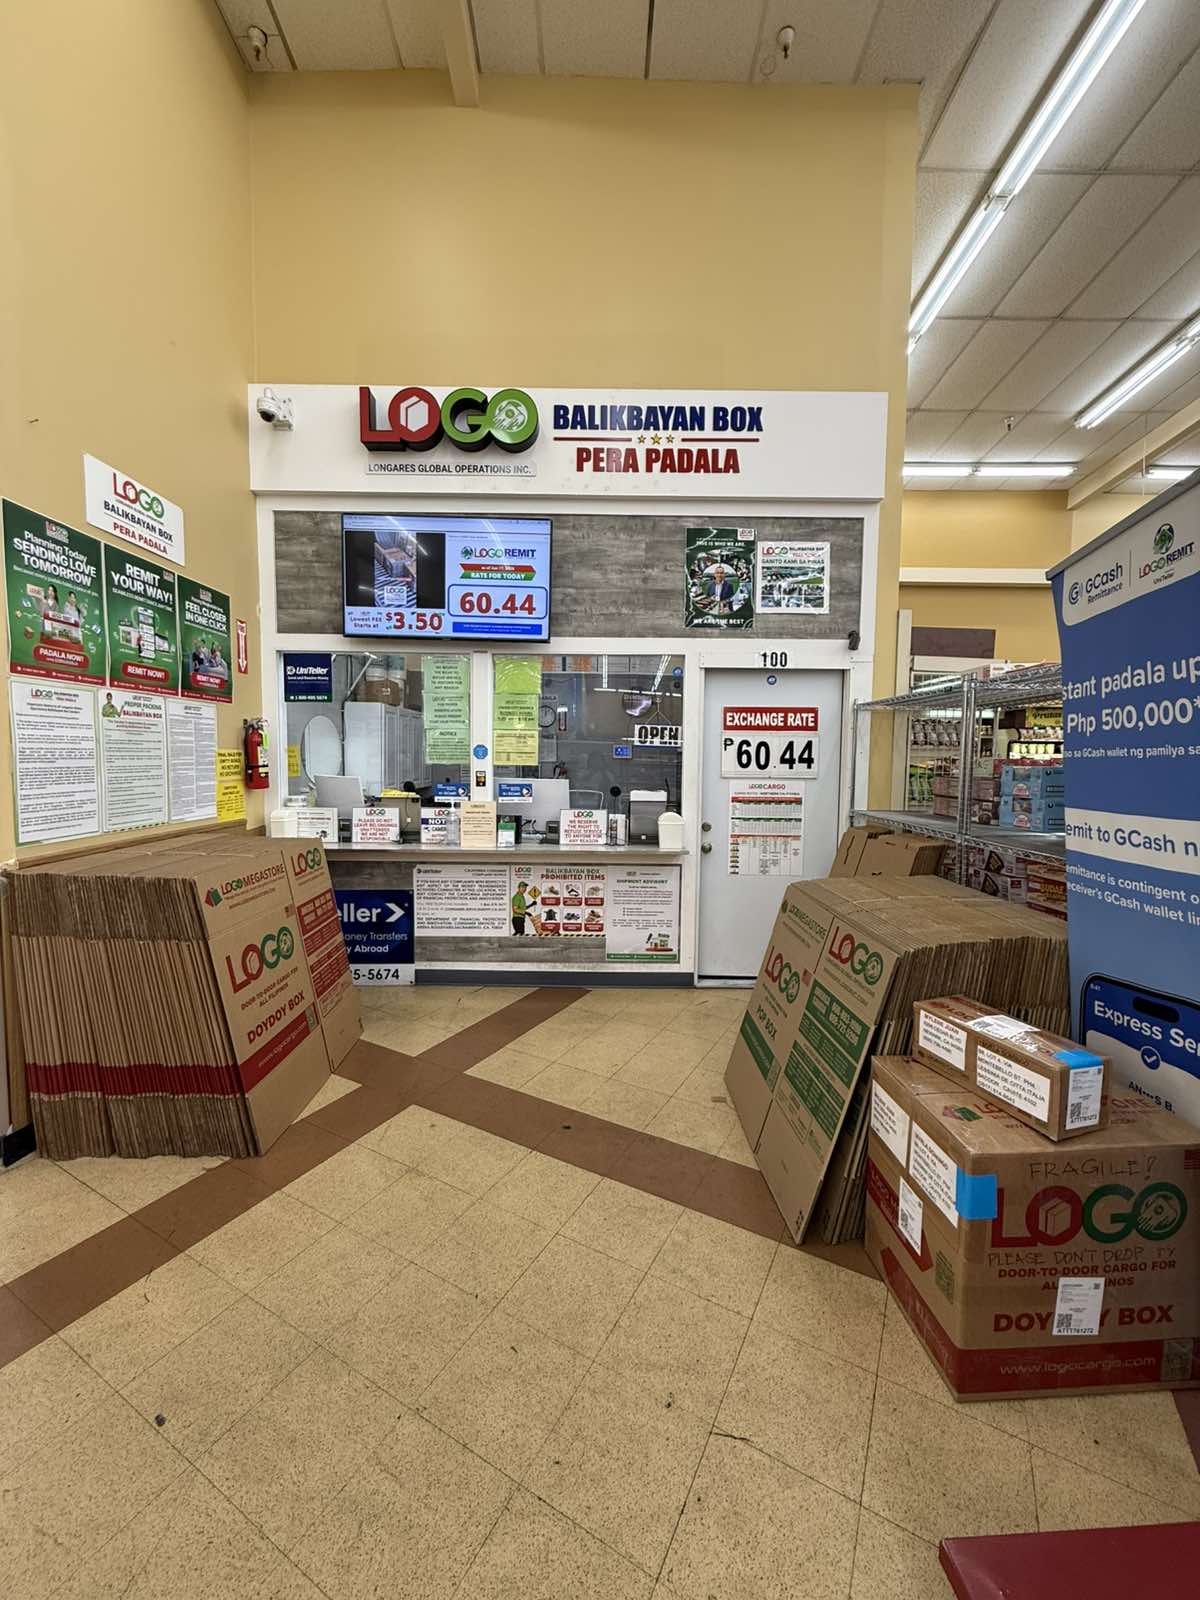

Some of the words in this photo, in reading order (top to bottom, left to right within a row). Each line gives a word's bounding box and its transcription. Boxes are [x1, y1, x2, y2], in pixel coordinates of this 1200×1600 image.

[360, 387, 539, 449] LOGO
[553, 405, 705, 432] BALIKBAYAN
[712, 406, 764, 432] BOX
[368, 463, 416, 473] LONGARES
[418, 463, 453, 473] GLOBAL
[455, 464, 512, 474] OPERATIONS
[513, 465, 532, 474] INC.
[576, 447, 640, 472] PERA
[645, 448, 740, 473] PADALA
[113, 472, 164, 518] LOGO
[104, 500, 157, 534] BALIKBAYAN
[158, 528, 174, 543] BOX
[24, 531, 63, 554] Planning
[113, 522, 137, 540] PERA
[138, 534, 168, 555] PADALA
[13, 538, 69, 567] SENDING
[70, 557, 96, 577] LOVE
[475, 547, 503, 558] LOGO
[505, 548, 537, 558] REMIT
[762, 547, 788, 556] LOGO
[1166, 542, 1195, 566] REMIT
[21, 553, 91, 587] TOMORROW
[125, 563, 160, 586] REMIT
[1085, 563, 1123, 595] GCash
[110, 570, 144, 594] YOUR
[145, 584, 173, 605] WAY!
[1087, 582, 1123, 605] Remittance
[185, 600, 201, 614] FEEL
[460, 592, 536, 615] 60.44
[385, 611, 443, 631] $3.50
[760, 652, 788, 667] 100
[1101, 661, 1165, 698] padala
[726, 712, 784, 727] EXCHANGE
[787, 712, 815, 727] RATE
[1067, 713, 1096, 736] Php
[638, 726, 679, 745] OPEN
[1082, 748, 1105, 758] GCash
[1130, 749, 1143, 758] ng
[1146, 744, 1185, 758] pamilya
[1096, 826, 1110, 843] to
[1114, 828, 1175, 854] GCash
[291, 848, 321, 876] LOGO
[221, 879, 243, 896] LOGO
[243, 863, 285, 888] MEGASTORE
[1107, 872, 1115, 885] is
[1118, 879, 1186, 902] contingent
[1104, 891, 1140, 910] GCash
[1144, 903, 1185, 922] wallet
[354, 944, 389, 953] Abroad
[370, 931, 408, 941] Transfers
[225, 926, 294, 993] LOGO
[828, 926, 884, 985] LOGO
[351, 969, 400, 980] 5-5674
[765, 946, 800, 1004] LOGO
[247, 1004, 287, 1044] DOYDOY
[288, 990, 305, 1011] BOX
[1094, 1000, 1162, 1040] Express
[991, 1181, 1188, 1248] LOGO
[987, 1252, 1046, 1268] PLEASE
[1054, 1250, 1097, 1265] DON'T
[1103, 1247, 1144, 1263] DROP
[998, 1264, 1099, 1279] DOOR-TO-DOOR
[1103, 1263, 1147, 1274] CARGO
[1151, 1260, 1177, 1271] FOR
[1041, 1281, 1059, 1291] AL
[1118, 1305, 1175, 1326] BOX
